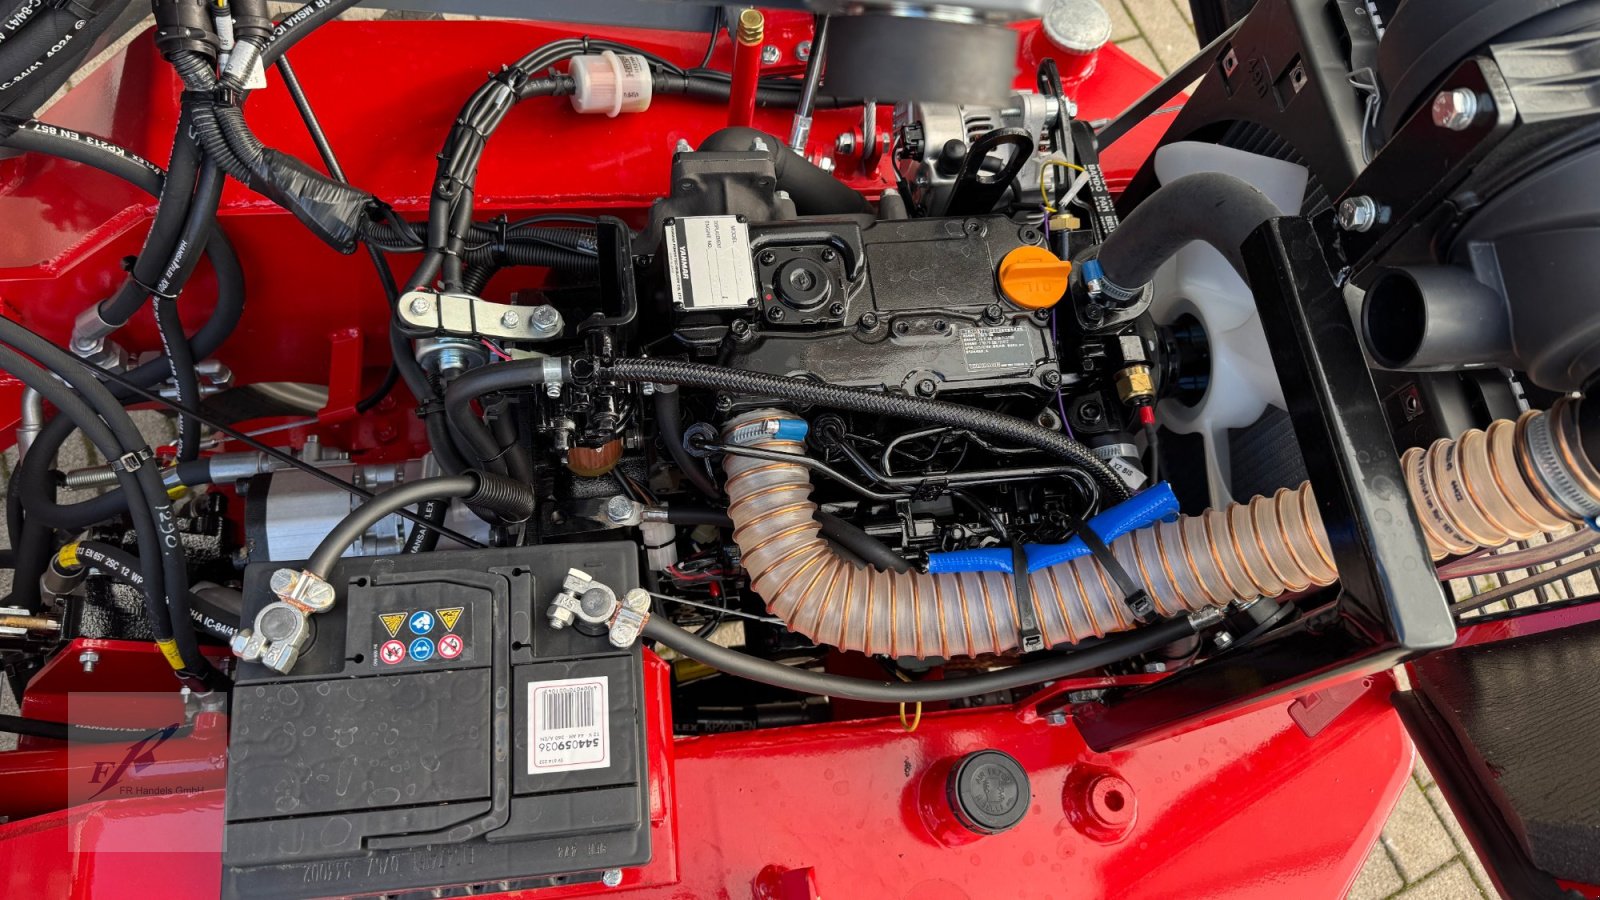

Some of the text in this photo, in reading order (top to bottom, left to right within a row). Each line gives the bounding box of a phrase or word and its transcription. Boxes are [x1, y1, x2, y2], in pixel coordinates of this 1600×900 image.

[5, 0, 41, 30] C-84/41
[284, 4, 315, 28] MSHA
[33, 123, 58, 136] 857
[60, 130, 80, 141] EN
[86, 135, 126, 158] KP213
[1087, 164, 1104, 192] BANDO
[1098, 194, 1111, 213] FAN
[679, 245, 690, 280] YANMAR
[85, 548, 93, 558] EN
[105, 557, 119, 570] 2SC
[121, 565, 130, 577] 12
[131, 571, 144, 585] WP
[203, 616, 239, 637] IC-84/41
[538, 738, 600, 752] 544059036
